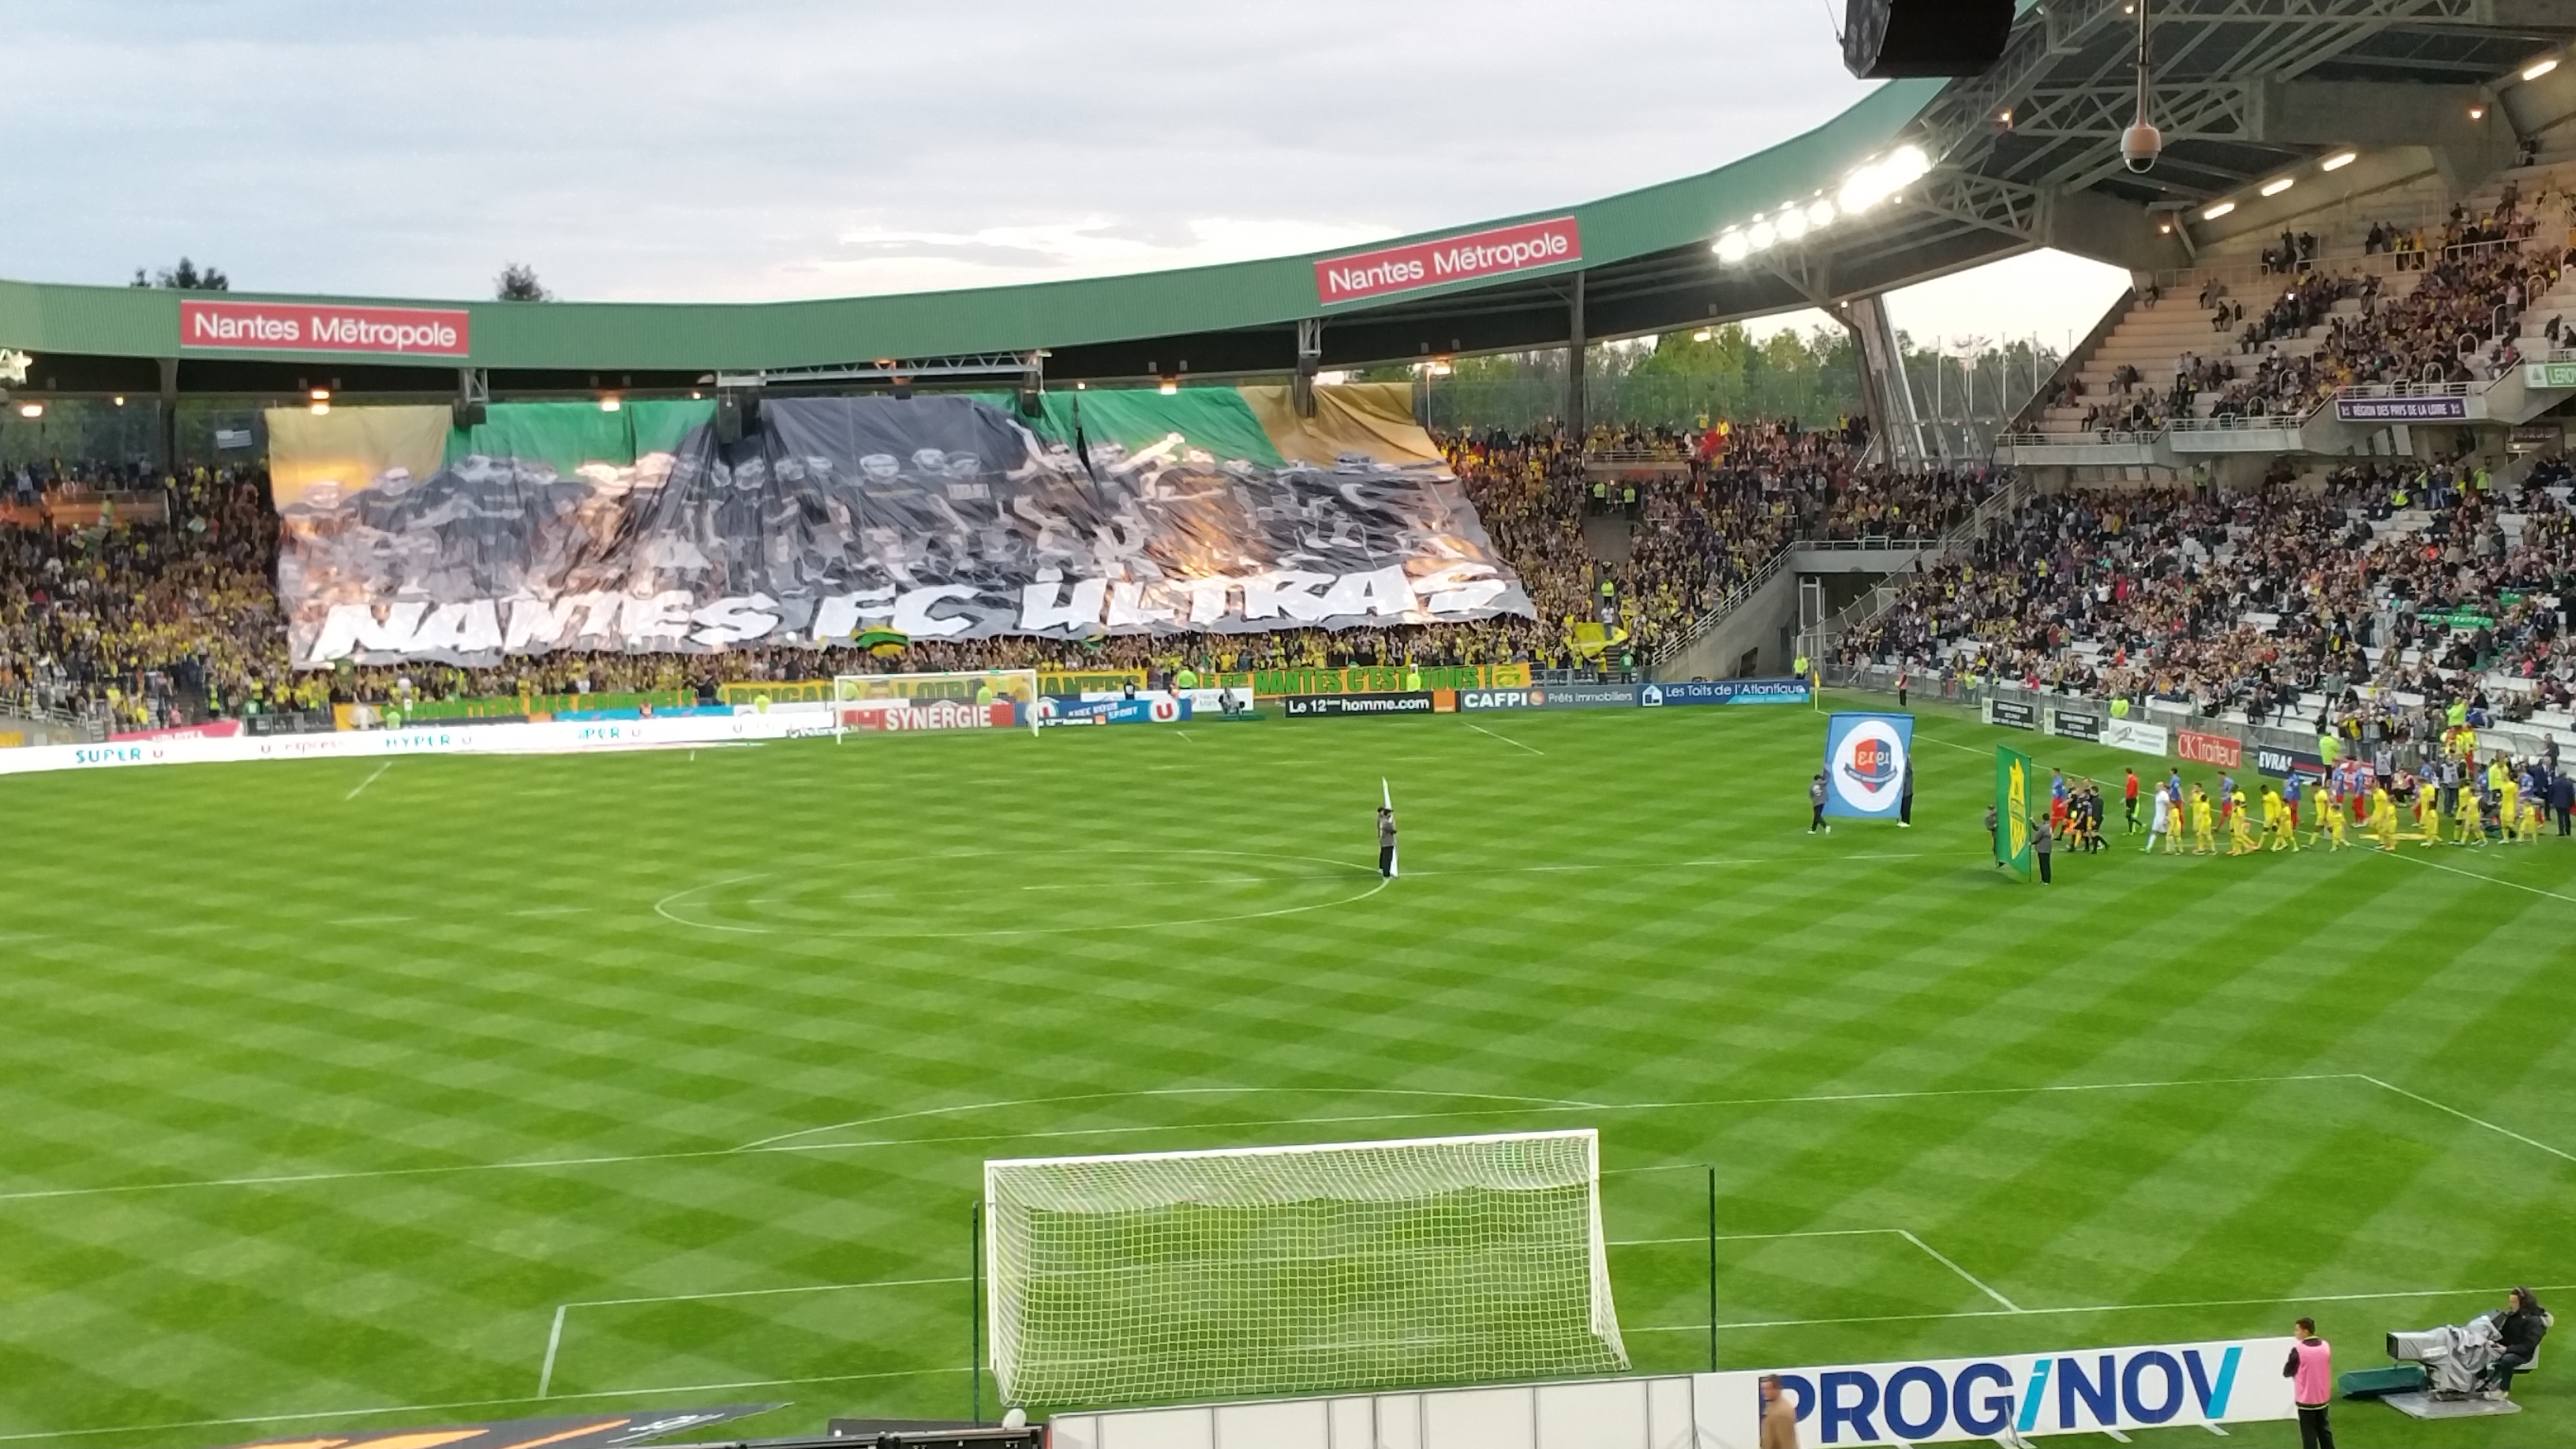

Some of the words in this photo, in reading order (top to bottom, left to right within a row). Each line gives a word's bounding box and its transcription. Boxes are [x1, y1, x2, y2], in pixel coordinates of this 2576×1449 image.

[1329, 260, 1424, 294] Nantes
[1434, 233, 1568, 275] Métropole
[194, 313, 300, 340] Nantes
[312, 316, 457, 351] Métropole
[2549, 367, 2576, 384] LERO
[2376, 404, 2389, 416] DES
[2390, 403, 2407, 416] PAYS
[2428, 403, 2447, 415] LOIRE
[309, 590, 781, 661] NANTES
[814, 583, 981, 641] FC
[1021, 562, 1509, 631] ULTRAS
[1254, 668, 1343, 696] NANTES
[1346, 667, 1407, 693] C'EST
[1666, 686, 1685, 698] Les
[1687, 684, 1713, 697] Toits
[1714, 683, 1732, 695] de
[1289, 698, 1308, 713] Le
[1342, 698, 1430, 712] homme.com
[1464, 691, 1528, 709] CAFPI
[1548, 692, 1573, 702] Prêts
[886, 705, 993, 731] SYNERGIE
[385, 733, 450, 749] HYPER
[76, 747, 141, 764] SUPER
[2196, 736, 2239, 767] Traiteur
